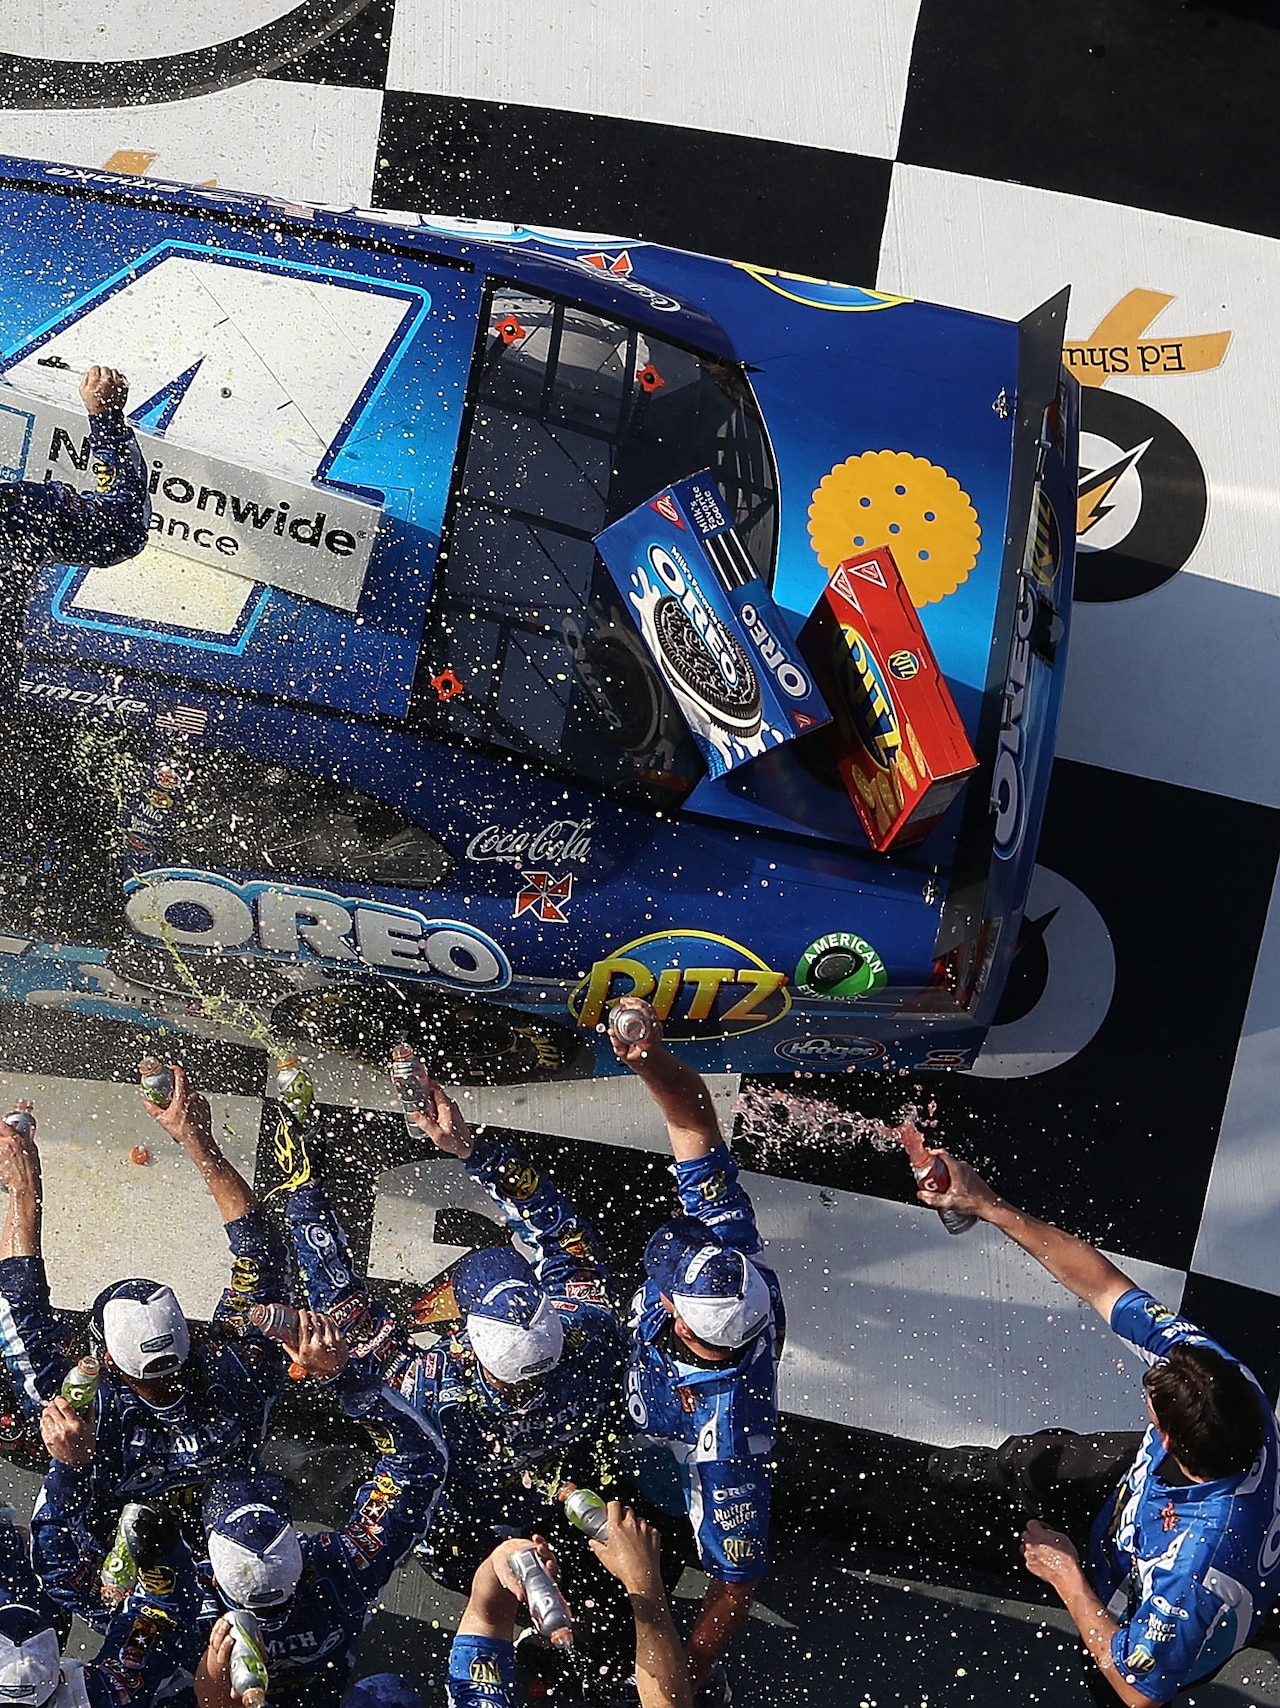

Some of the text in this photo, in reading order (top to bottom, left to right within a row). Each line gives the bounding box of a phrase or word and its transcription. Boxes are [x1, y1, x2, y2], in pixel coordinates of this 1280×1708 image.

[1062, 343, 1186, 373] Ed Shu
[49, 427, 357, 558] Nionwide
[693, 486, 716, 531] Favorite
[703, 491, 726, 527] Cookie
[690, 501, 710, 534] Milk's
[650, 547, 738, 684] OREO
[740, 603, 807, 697] OREO
[889, 650, 918, 679] RITZ
[466, 818, 596, 862] Coca-Cola
[125, 879, 502, 984] OREO
[803, 932, 884, 975] AMERICAN
[577, 957, 789, 1028] RITZ
[797, 983, 870, 1002] ETHANOL
[789, 1039, 877, 1059] Kroger
[712, 1482, 756, 1504] OREO
[713, 1502, 752, 1523] Nutter
[720, 1510, 758, 1531] Butter
[723, 1537, 755, 1563] RITZ
